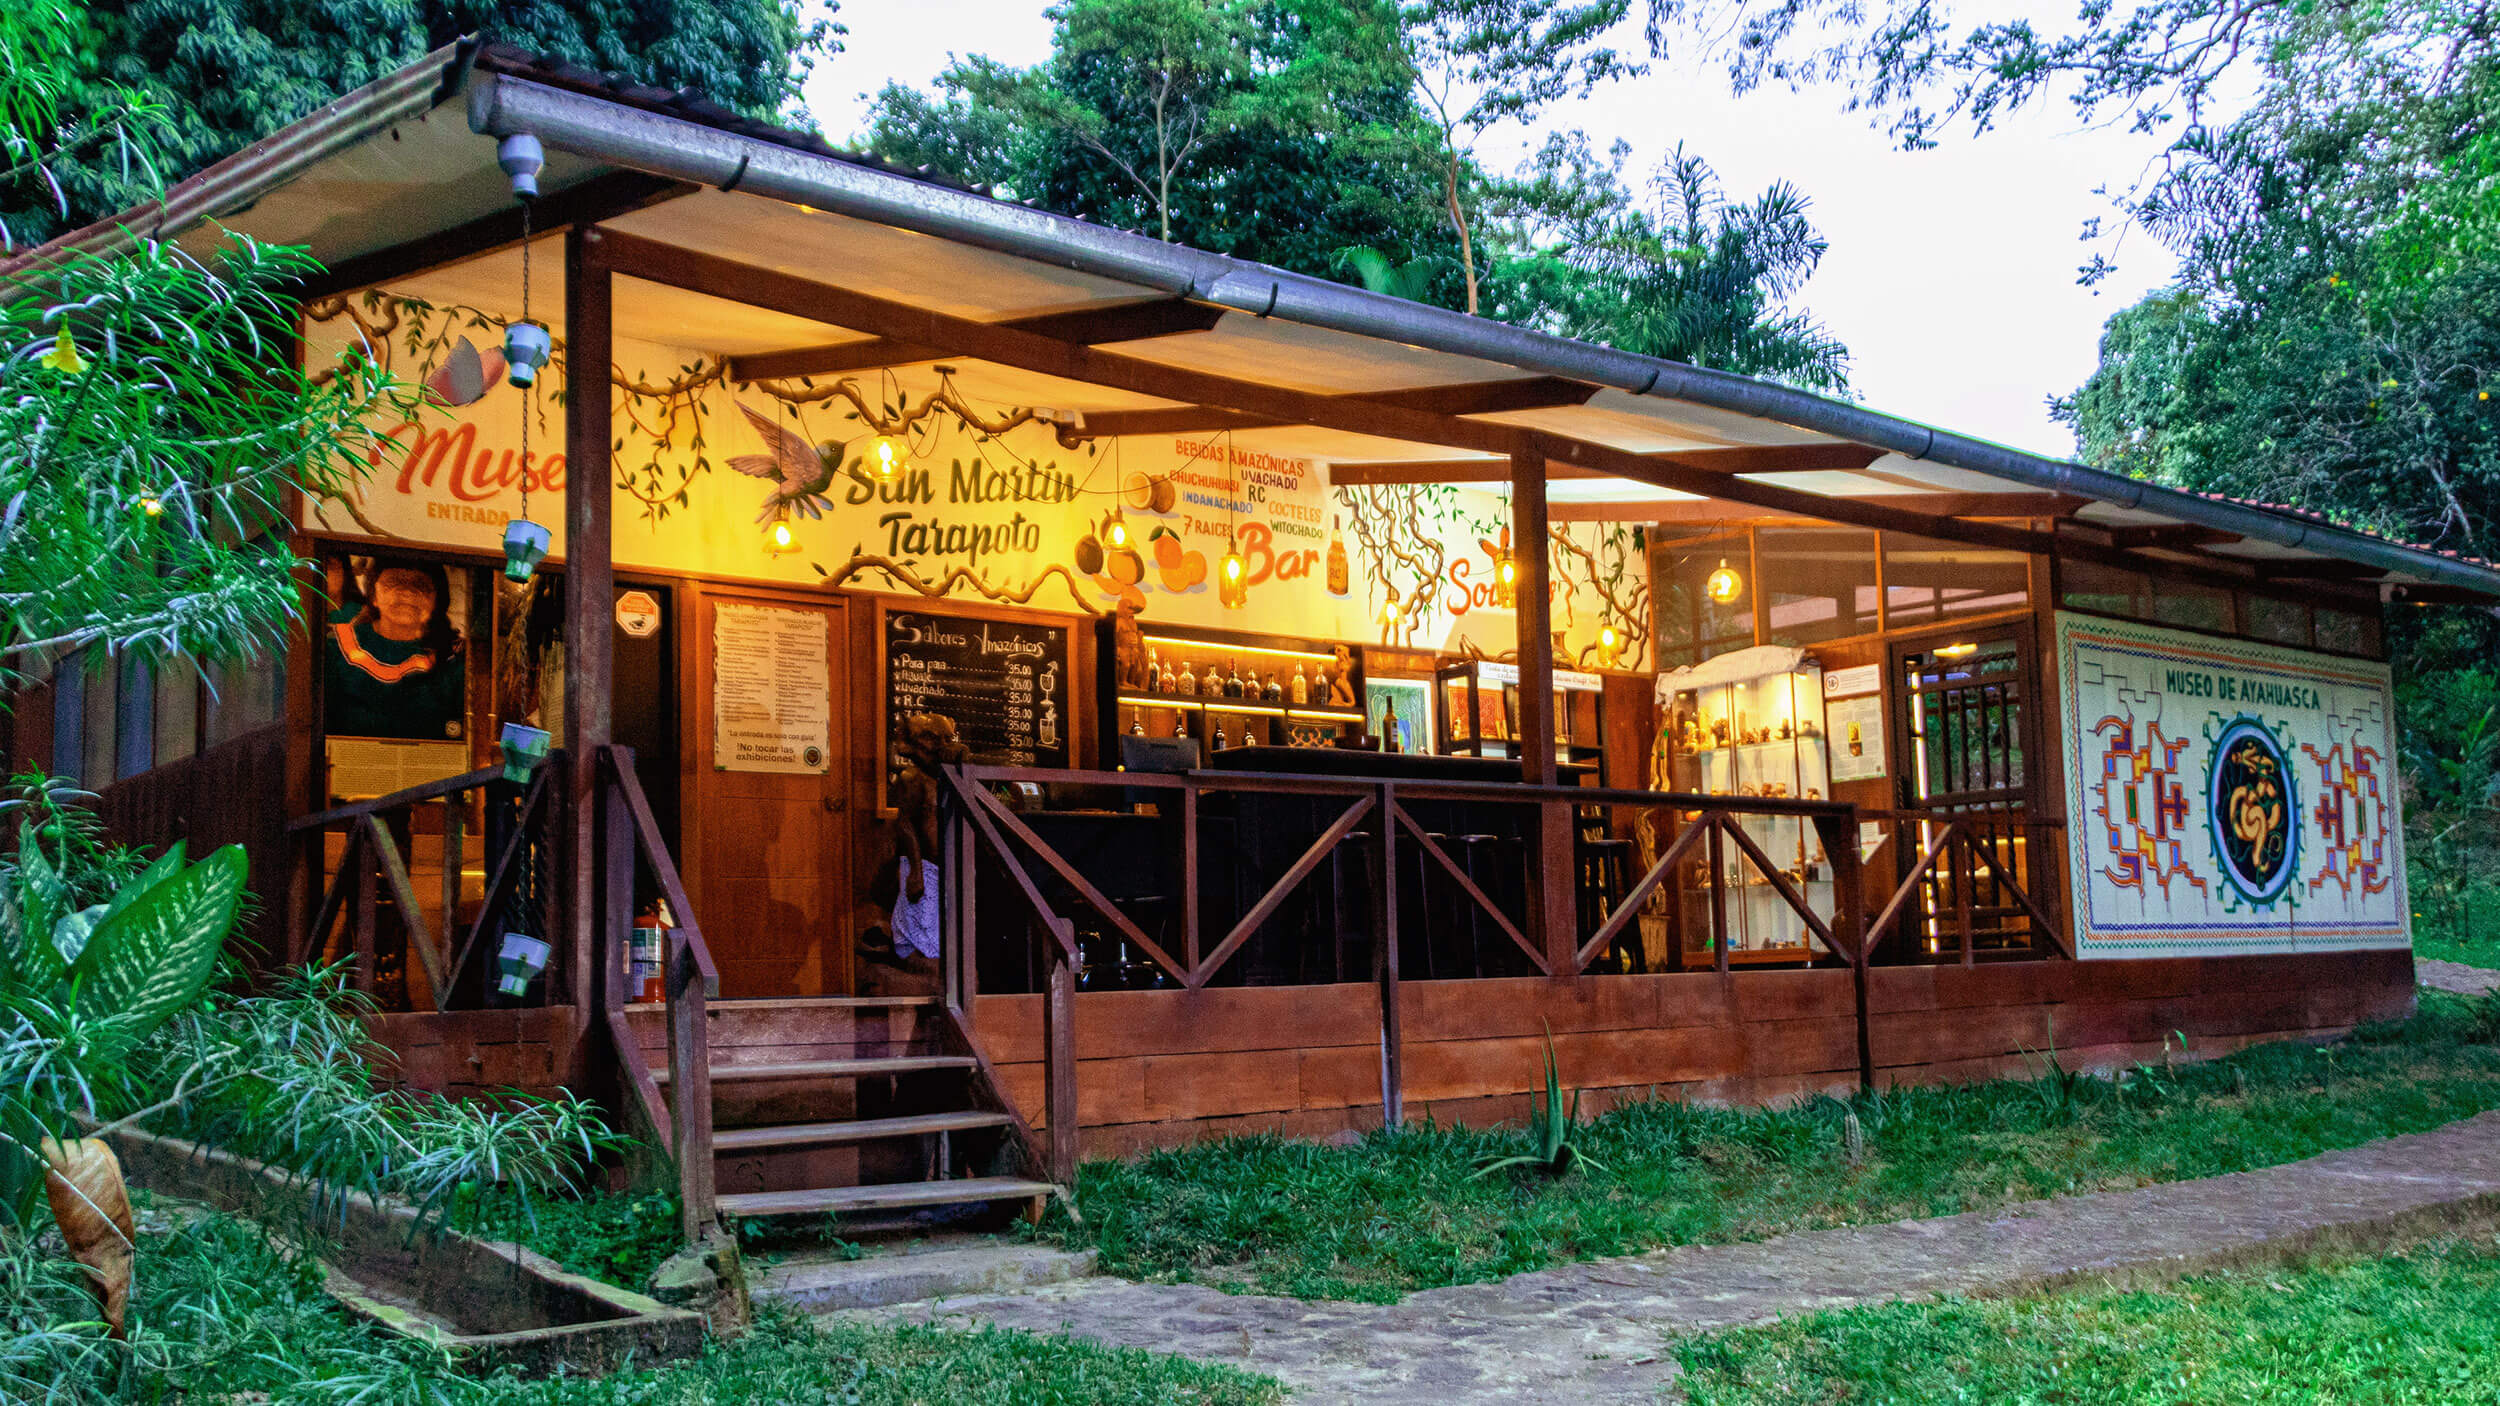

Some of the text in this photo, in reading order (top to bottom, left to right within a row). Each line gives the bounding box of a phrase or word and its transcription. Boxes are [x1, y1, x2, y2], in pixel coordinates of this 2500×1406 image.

[367, 421, 567, 501] Muse
[1175, 440, 1304, 478] BEBIDAS AMAZÓNICAS
[845, 456, 1076, 505] San Martín
[1241, 470, 1297, 490] UVACHADO
[1248, 484, 1266, 503] RC
[427, 501, 511, 527] ENTRADA
[1268, 501, 1321, 523] COCTELES
[1183, 515, 1233, 538] 7 RAICES
[1270, 519, 1323, 538] WITOCHADO
[879, 511, 1040, 567] Tarapoto
[1237, 522, 1320, 587] Bar
[1008, 663, 1032, 675] 35.00
[1008, 692, 1032, 704] 35.00
[2166, 668, 2321, 710] MUSEO DE AYAHUASCA
[1008, 706, 1033, 719] 35.00
[755, 744, 778, 753] tocar
[781, 745, 794, 754] las
